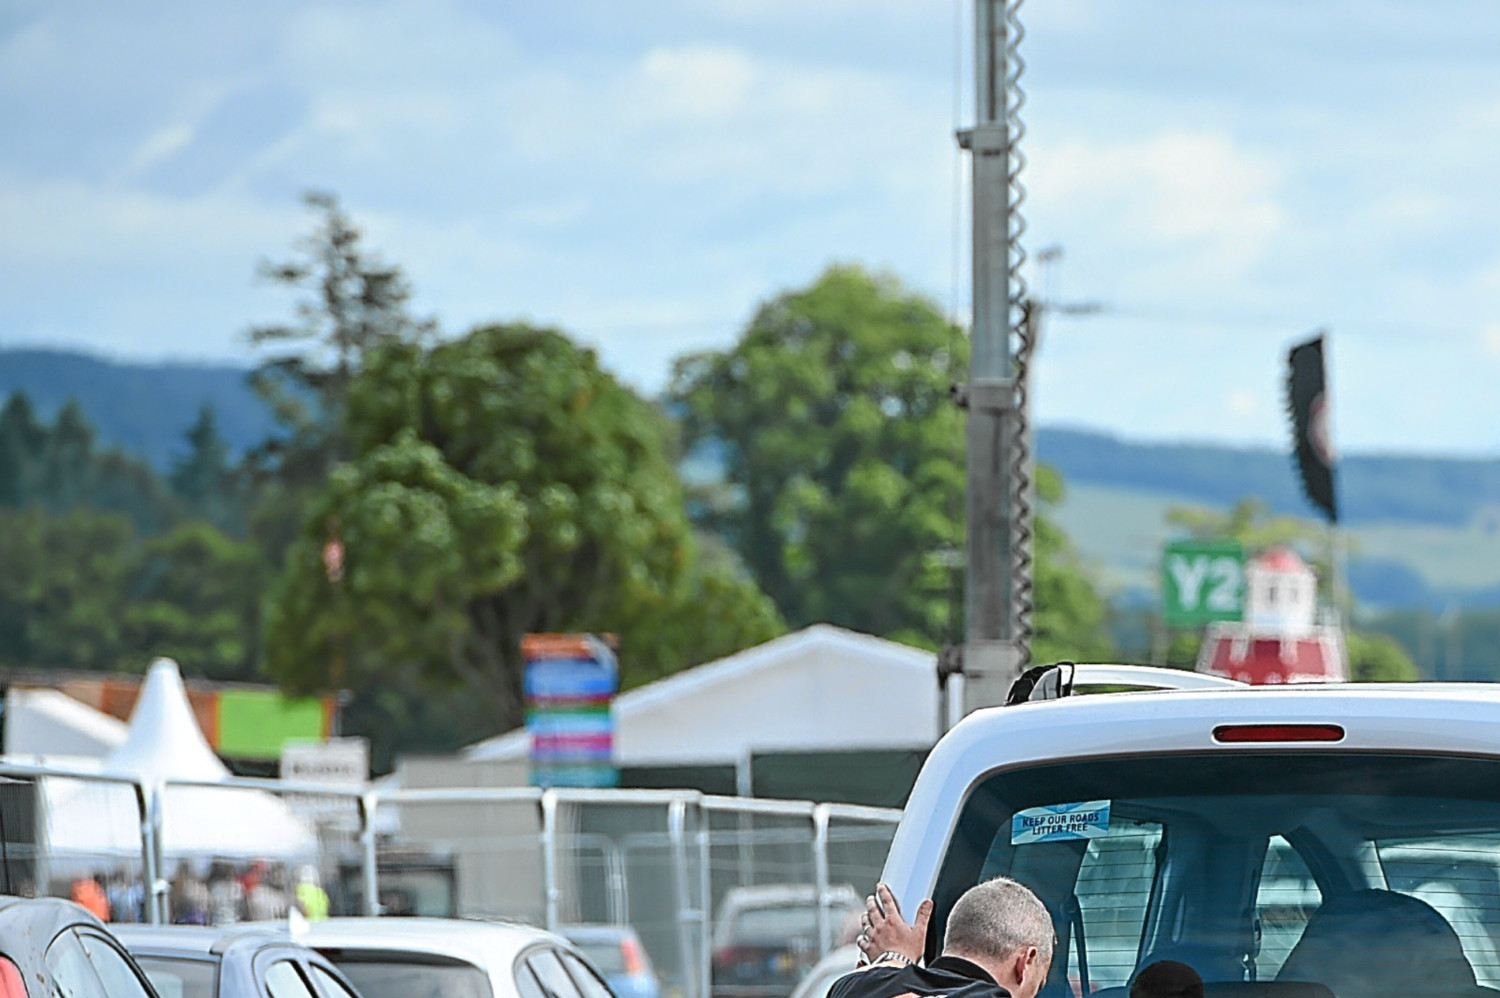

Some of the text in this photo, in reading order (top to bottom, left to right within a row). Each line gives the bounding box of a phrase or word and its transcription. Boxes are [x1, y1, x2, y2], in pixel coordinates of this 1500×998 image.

[1170, 554, 1241, 612] Y2
[1023, 813, 1099, 828] KEEP OUR ROADS
[1032, 823, 1088, 836] LITTER FREE
